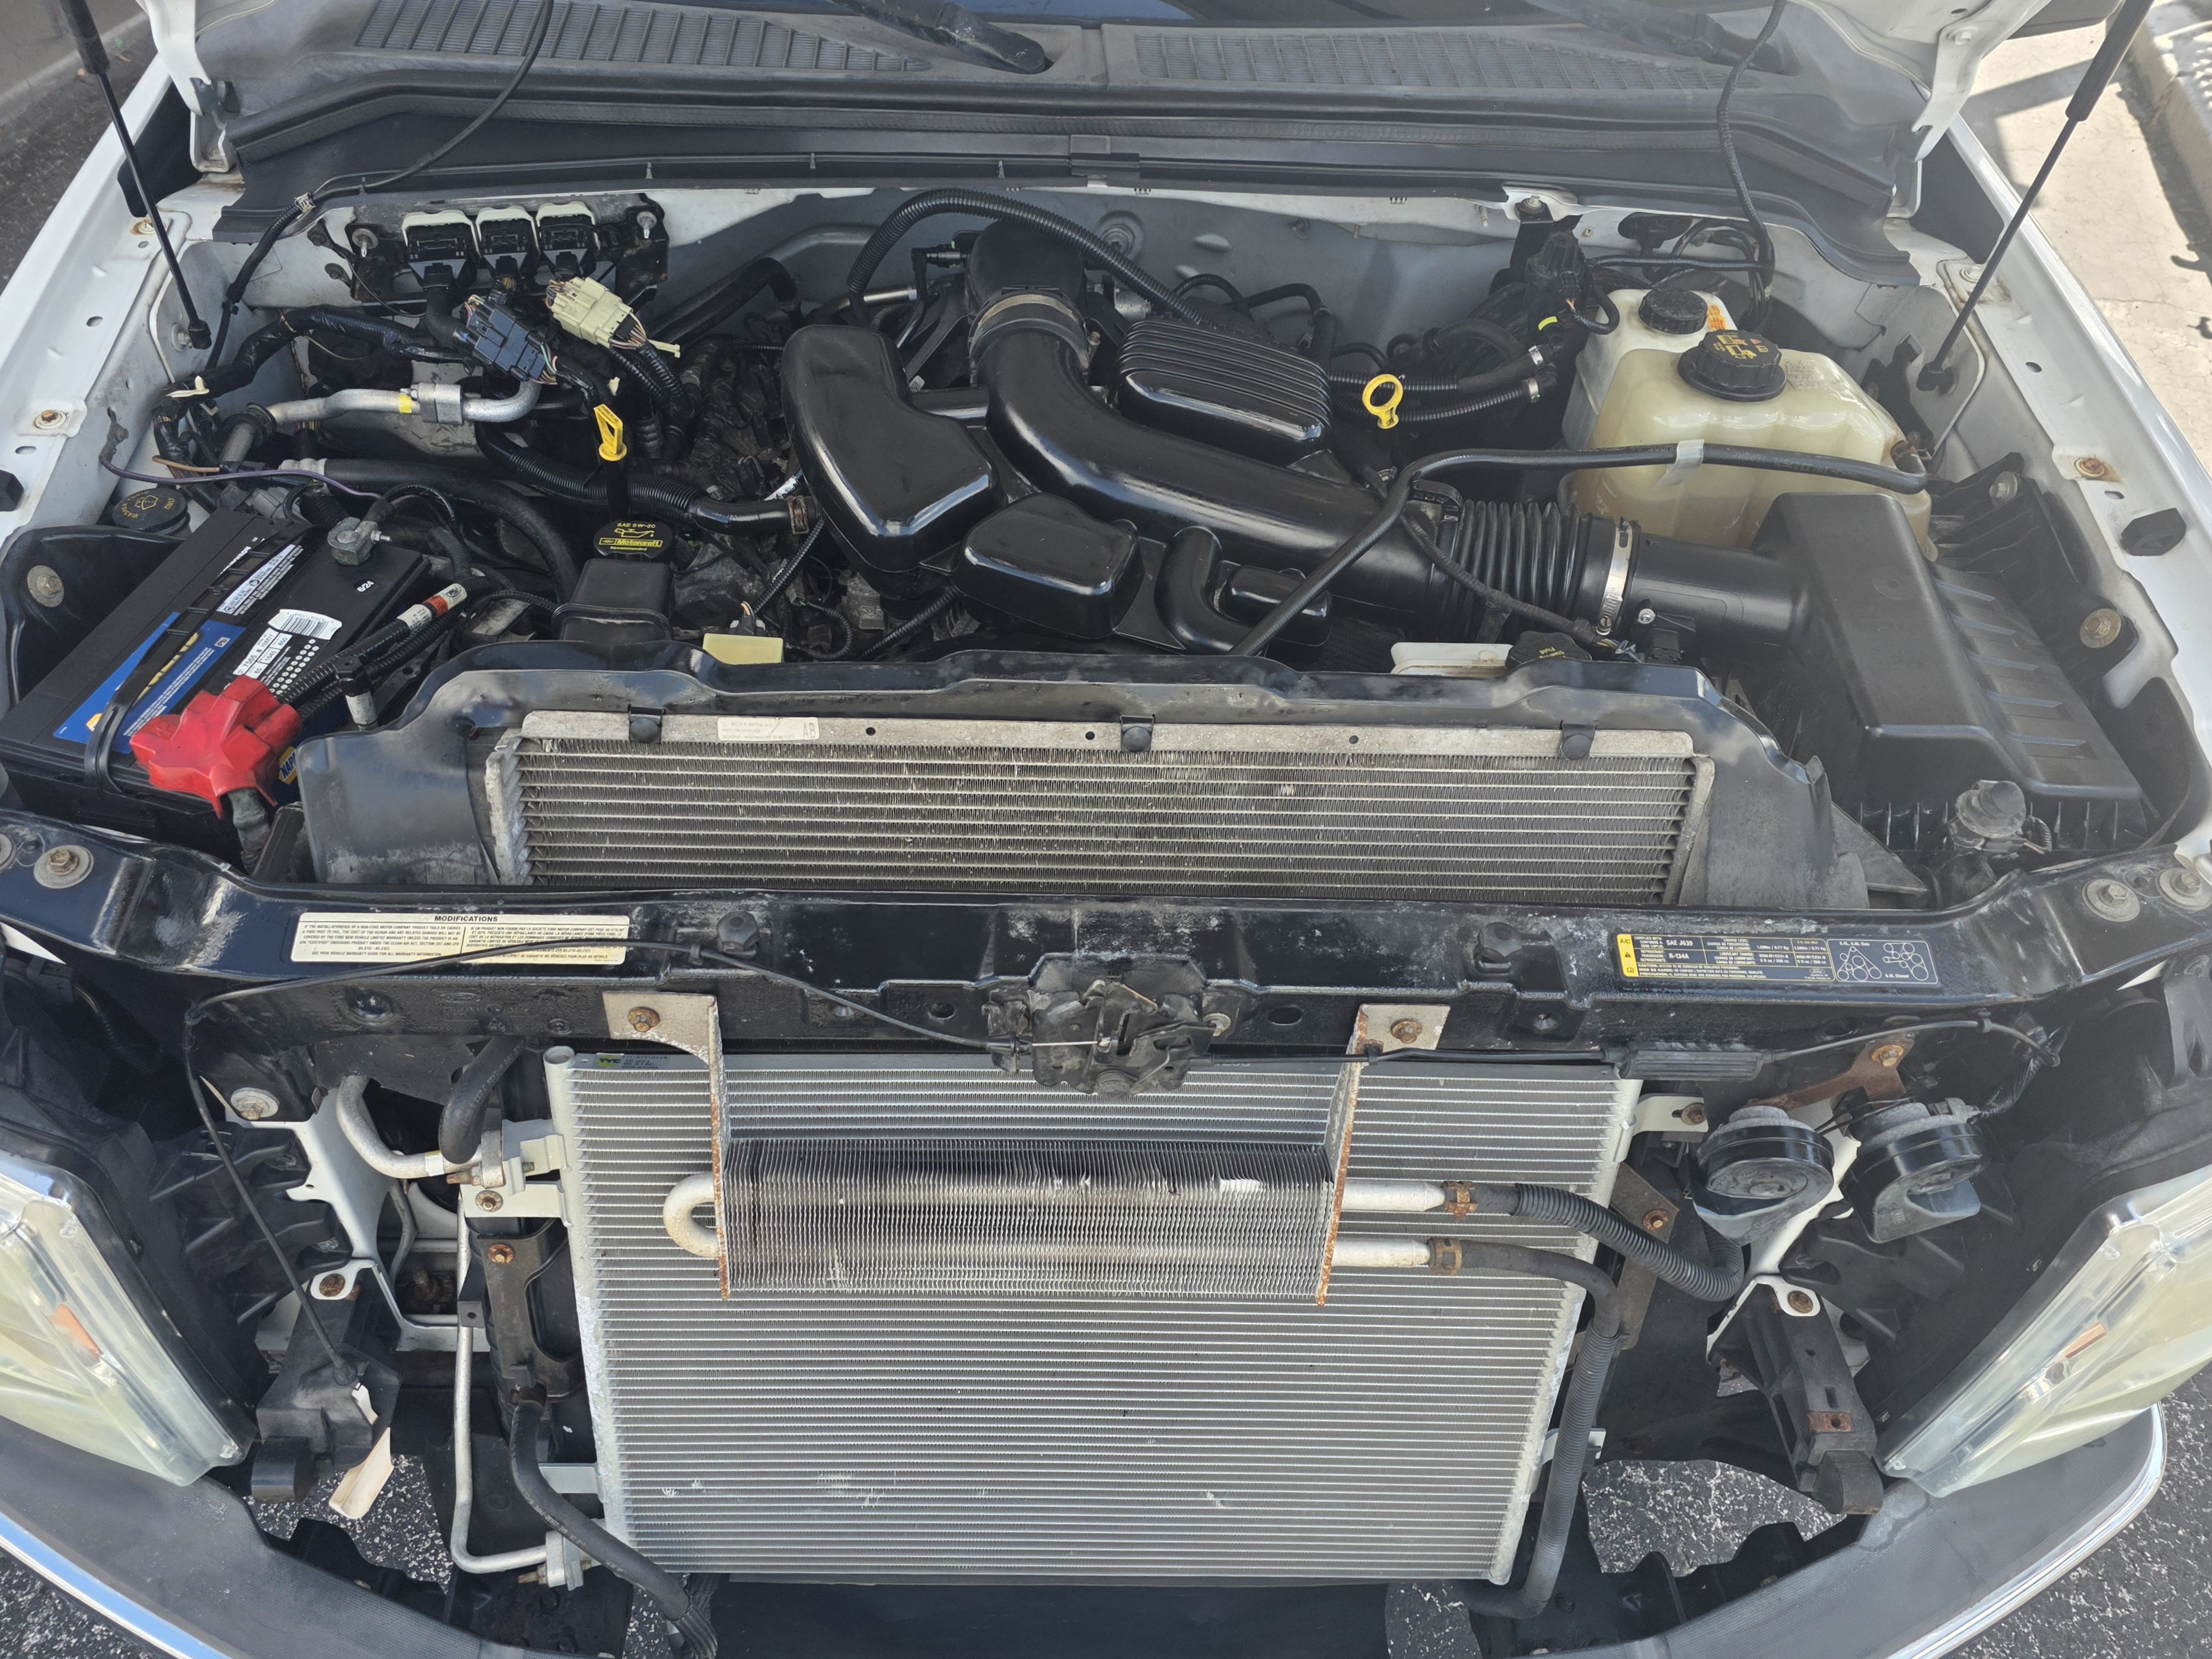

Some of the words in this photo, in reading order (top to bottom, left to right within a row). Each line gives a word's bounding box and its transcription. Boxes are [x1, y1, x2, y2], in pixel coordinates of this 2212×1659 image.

[164, 497, 176, 510] ONLY
[356, 580, 375, 593] 6/24
[216, 638, 229, 647] Pb
[1539, 647, 1556, 655] Fluid
[242, 654, 257, 667] 7565
[803, 722, 817, 739] AB
